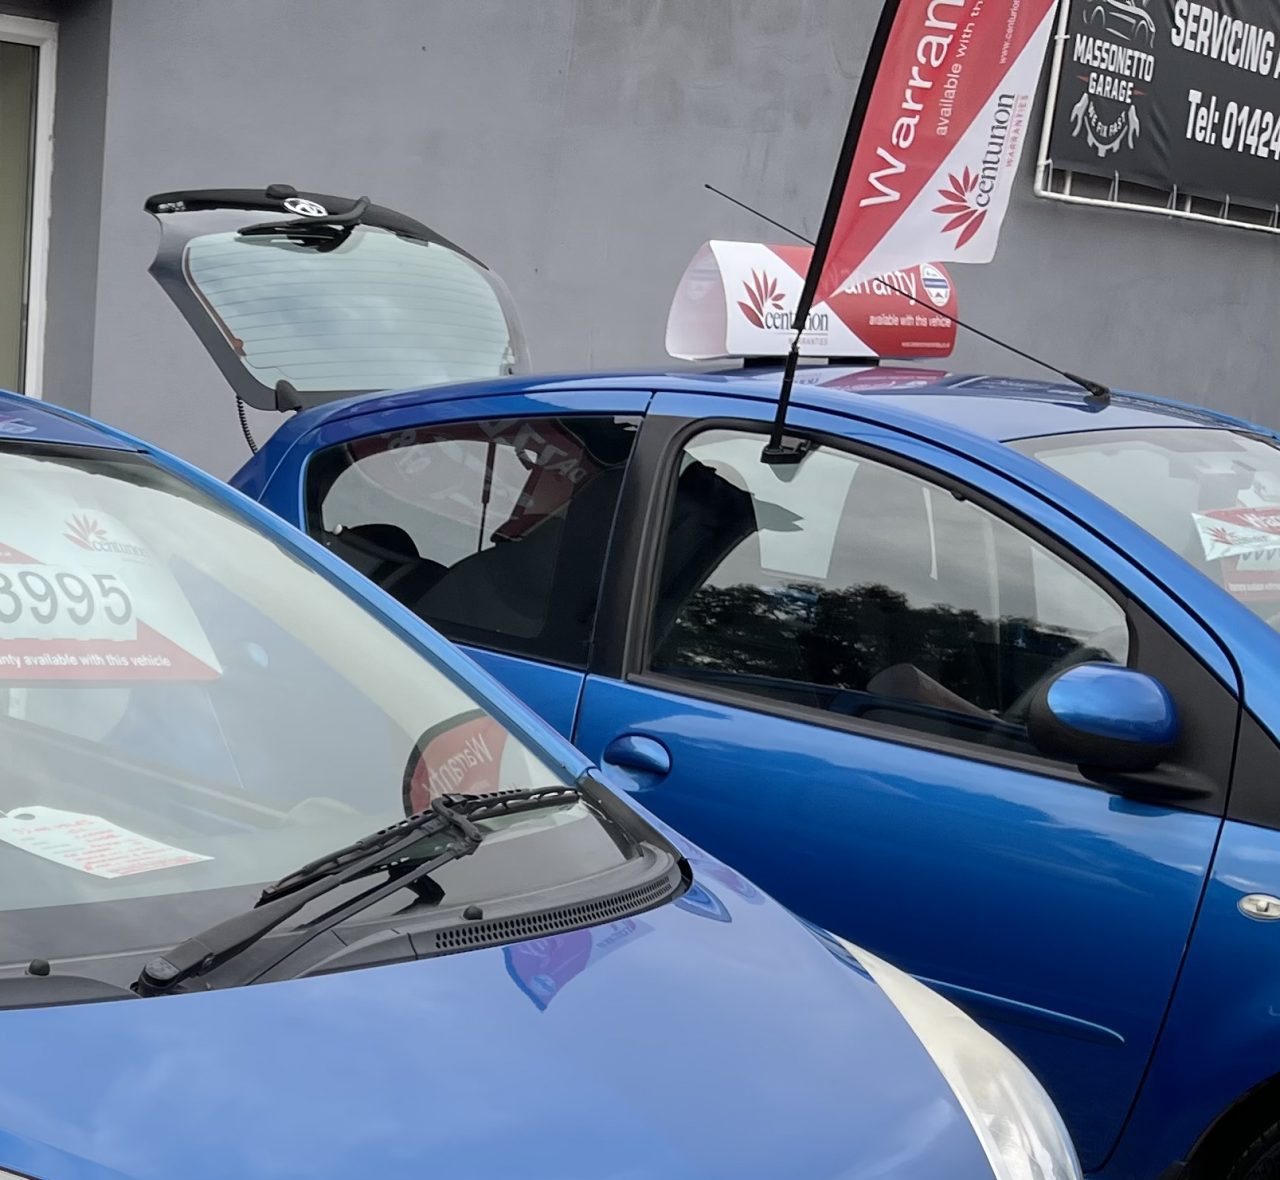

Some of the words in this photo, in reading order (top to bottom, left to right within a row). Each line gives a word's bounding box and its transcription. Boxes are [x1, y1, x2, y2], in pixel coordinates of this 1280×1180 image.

[1073, 33, 1155, 82] MASSONETTO
[1171, 0, 1275, 76] SERVICING
[936, 63, 962, 136] available
[956, 23, 975, 58] with
[1088, 72, 1134, 103] GARAGE
[976, 93, 1015, 208] centurion
[1186, 89, 1219, 145] Tel:
[1221, 101, 1280, 160] 01424
[765, 310, 829, 331] cention
[24, 653, 78, 666] available
[81, 653, 106, 666] with
[106, 653, 129, 666] this
[132, 655, 171, 667] vehicle
